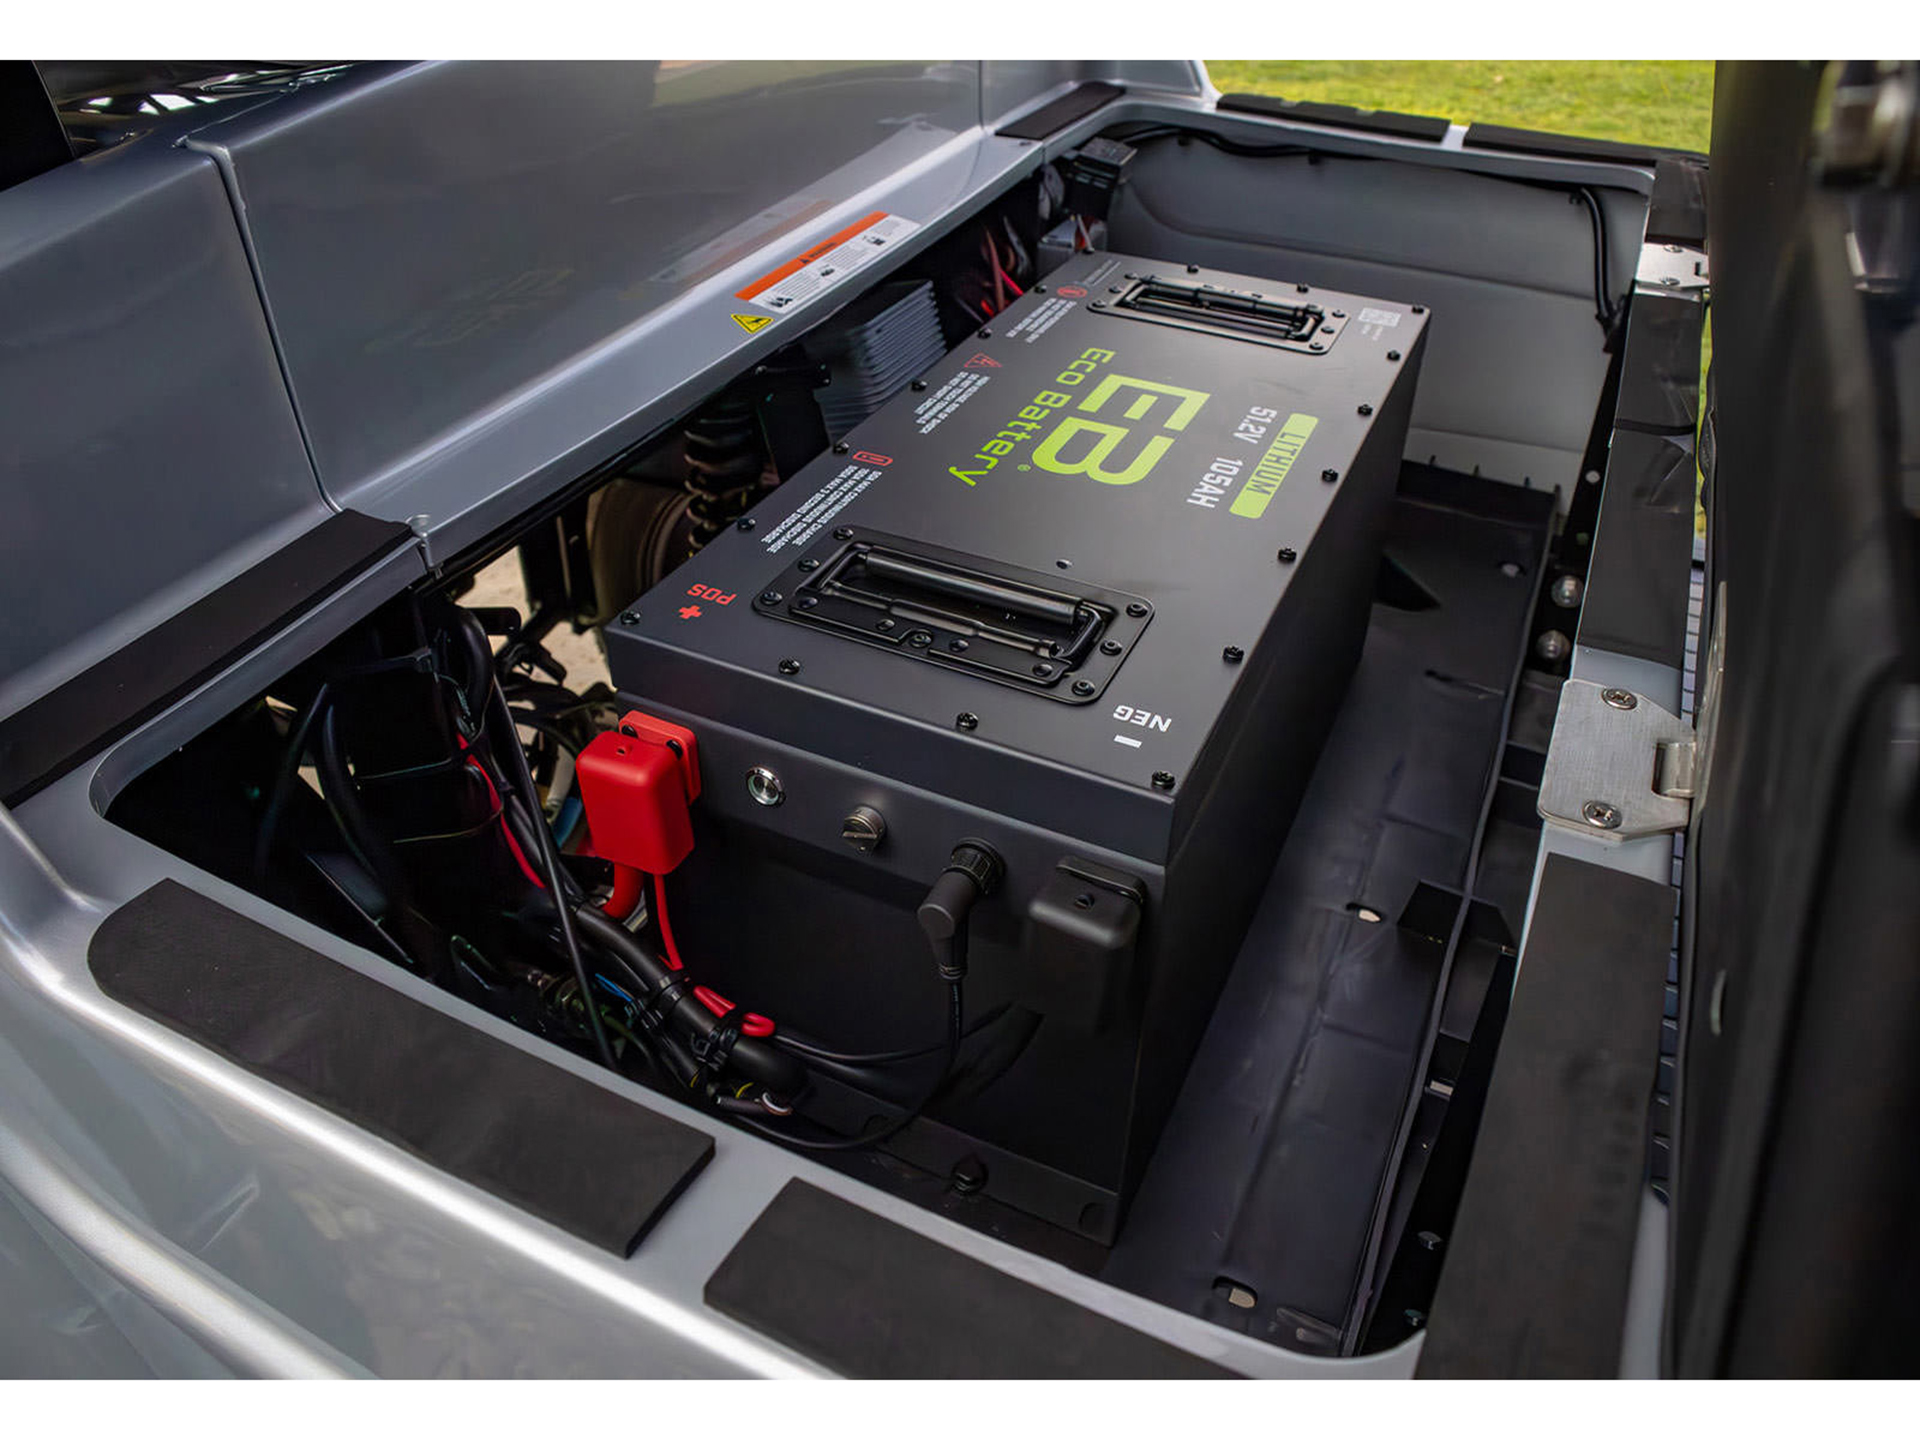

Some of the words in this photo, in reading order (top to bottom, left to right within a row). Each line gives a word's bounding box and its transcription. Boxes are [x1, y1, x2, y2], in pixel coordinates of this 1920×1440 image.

[1056, 348, 1116, 386] Eco
[948, 390, 1072, 487] Battery
[1032, 373, 1211, 486] EB
[1233, 406, 1277, 444] 51.2V
[1246, 431, 1306, 496] LITHIUM
[826, 478, 843, 489] MAX
[840, 480, 856, 491] MAX
[854, 481, 871, 492] MAX
[1186, 457, 1244, 508] 105AH
[797, 493, 826, 513] SECOND
[802, 491, 845, 523] CONTINUOUS
[817, 492, 858, 523] CONTINUOUS
[761, 513, 802, 543] DISCHARGE
[767, 522, 807, 553] DISCHARGE
[793, 523, 822, 545] CHARGE
[686, 583, 737, 606] POS
[1113, 704, 1172, 733] NEG
